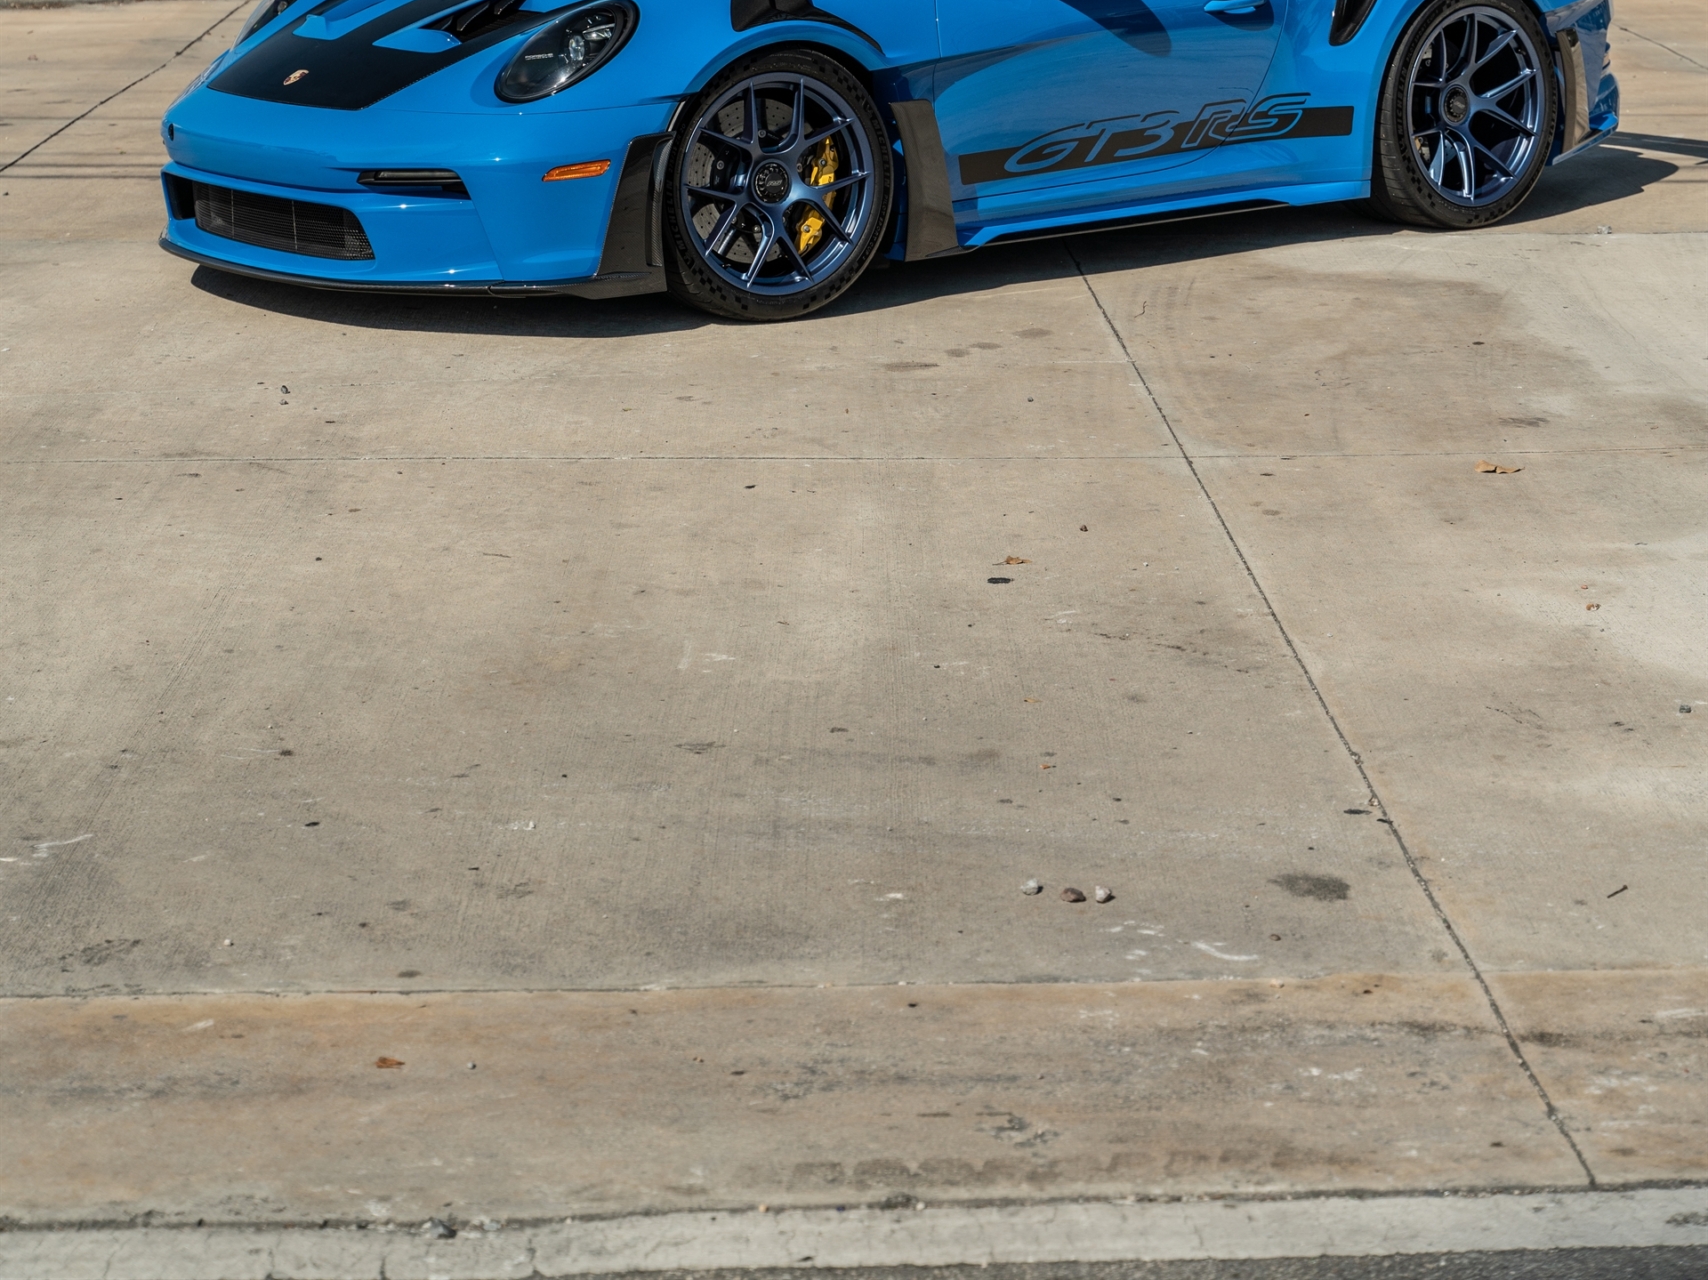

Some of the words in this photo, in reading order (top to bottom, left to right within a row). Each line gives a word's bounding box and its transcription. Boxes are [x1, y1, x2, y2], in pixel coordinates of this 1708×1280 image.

[1396, 67, 1407, 135] MICHELIN
[870, 115, 890, 188] MICHELIN
[666, 179, 686, 251] MICHELIN
